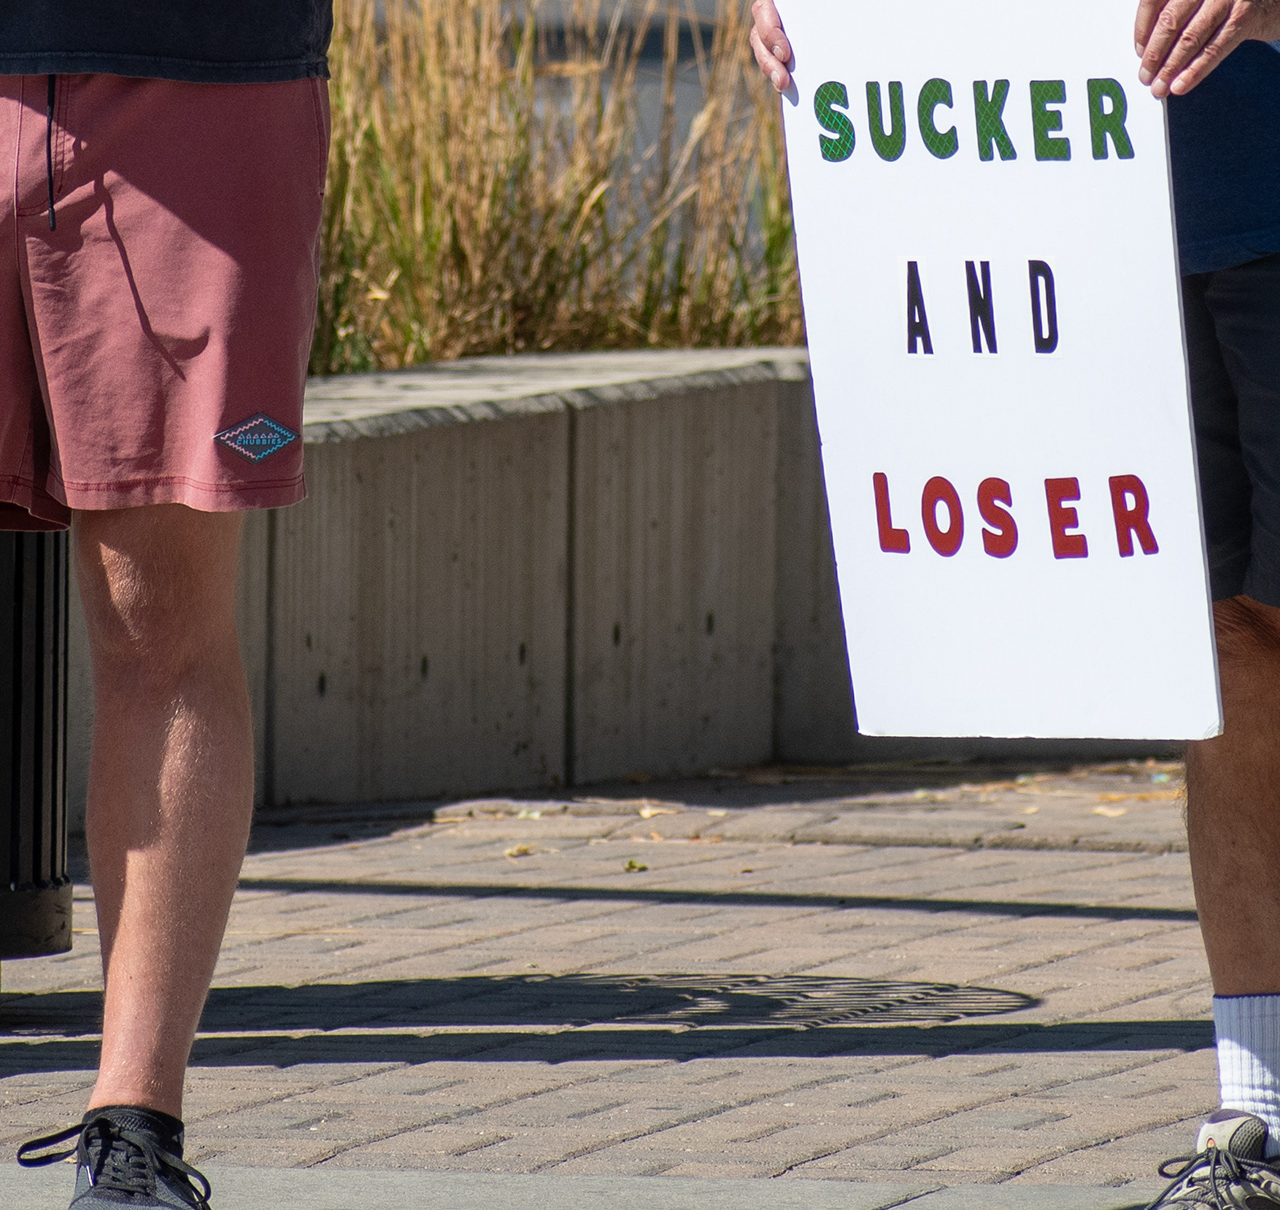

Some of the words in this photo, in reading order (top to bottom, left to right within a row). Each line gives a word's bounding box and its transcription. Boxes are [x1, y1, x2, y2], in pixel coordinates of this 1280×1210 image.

[813, 77, 1135, 163] SUCKER
[906, 259, 1059, 356] AND
[872, 471, 1160, 560] LOSER
